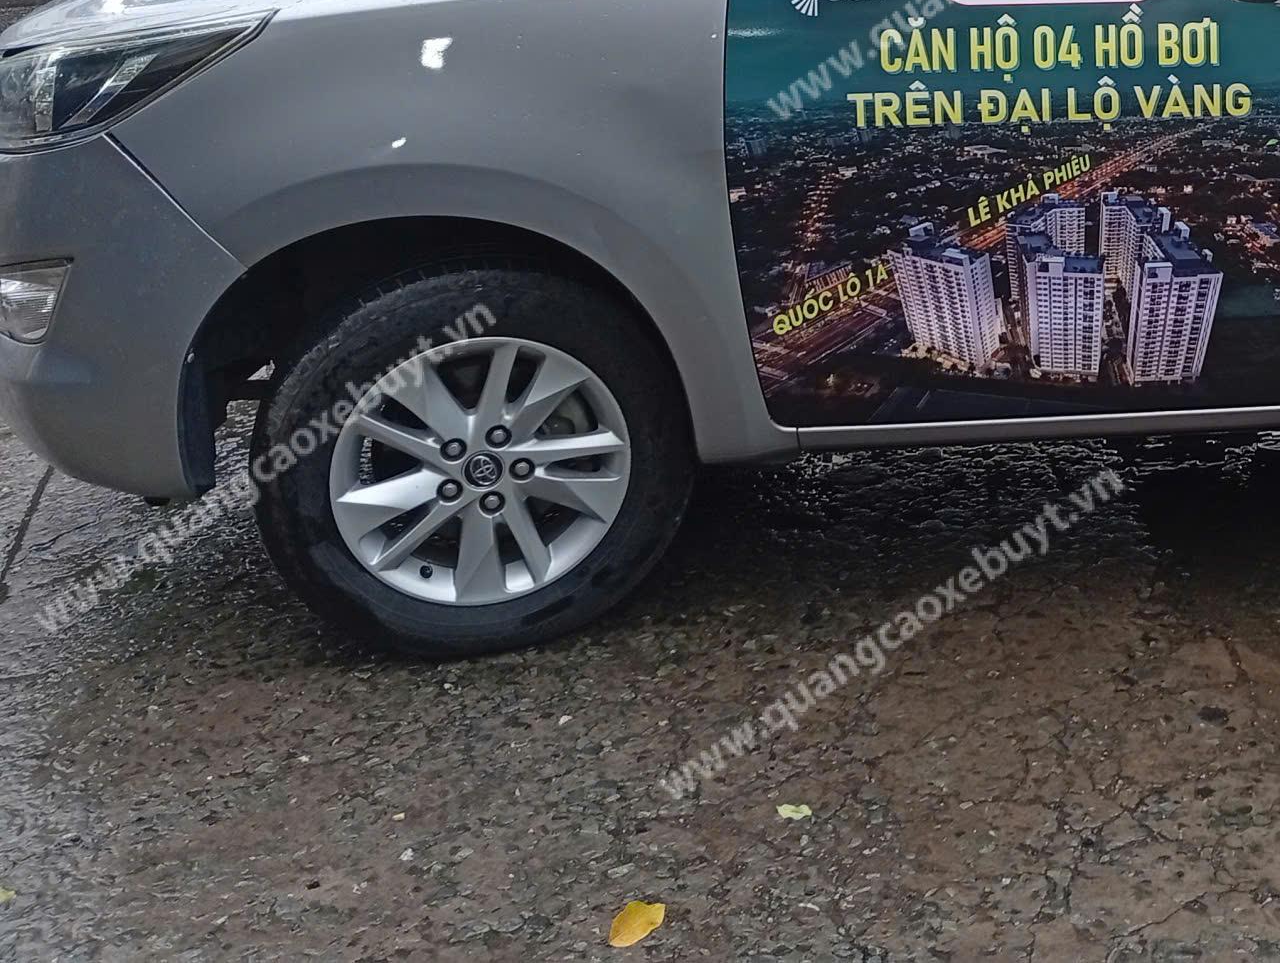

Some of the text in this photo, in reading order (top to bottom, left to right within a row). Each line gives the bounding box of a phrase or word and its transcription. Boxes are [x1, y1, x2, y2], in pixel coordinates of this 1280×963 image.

[880, 2, 1220, 83] CĂN HỘ 04 HỒ BƠI
[847, 73, 1253, 134] TRÊN ĐẠI LỘ VÀNG
[967, 196, 991, 228] LÊ
[996, 174, 1040, 215] KHẢ
[773, 288, 834, 335] QUỐC
[865, 264, 889, 290] 1A
